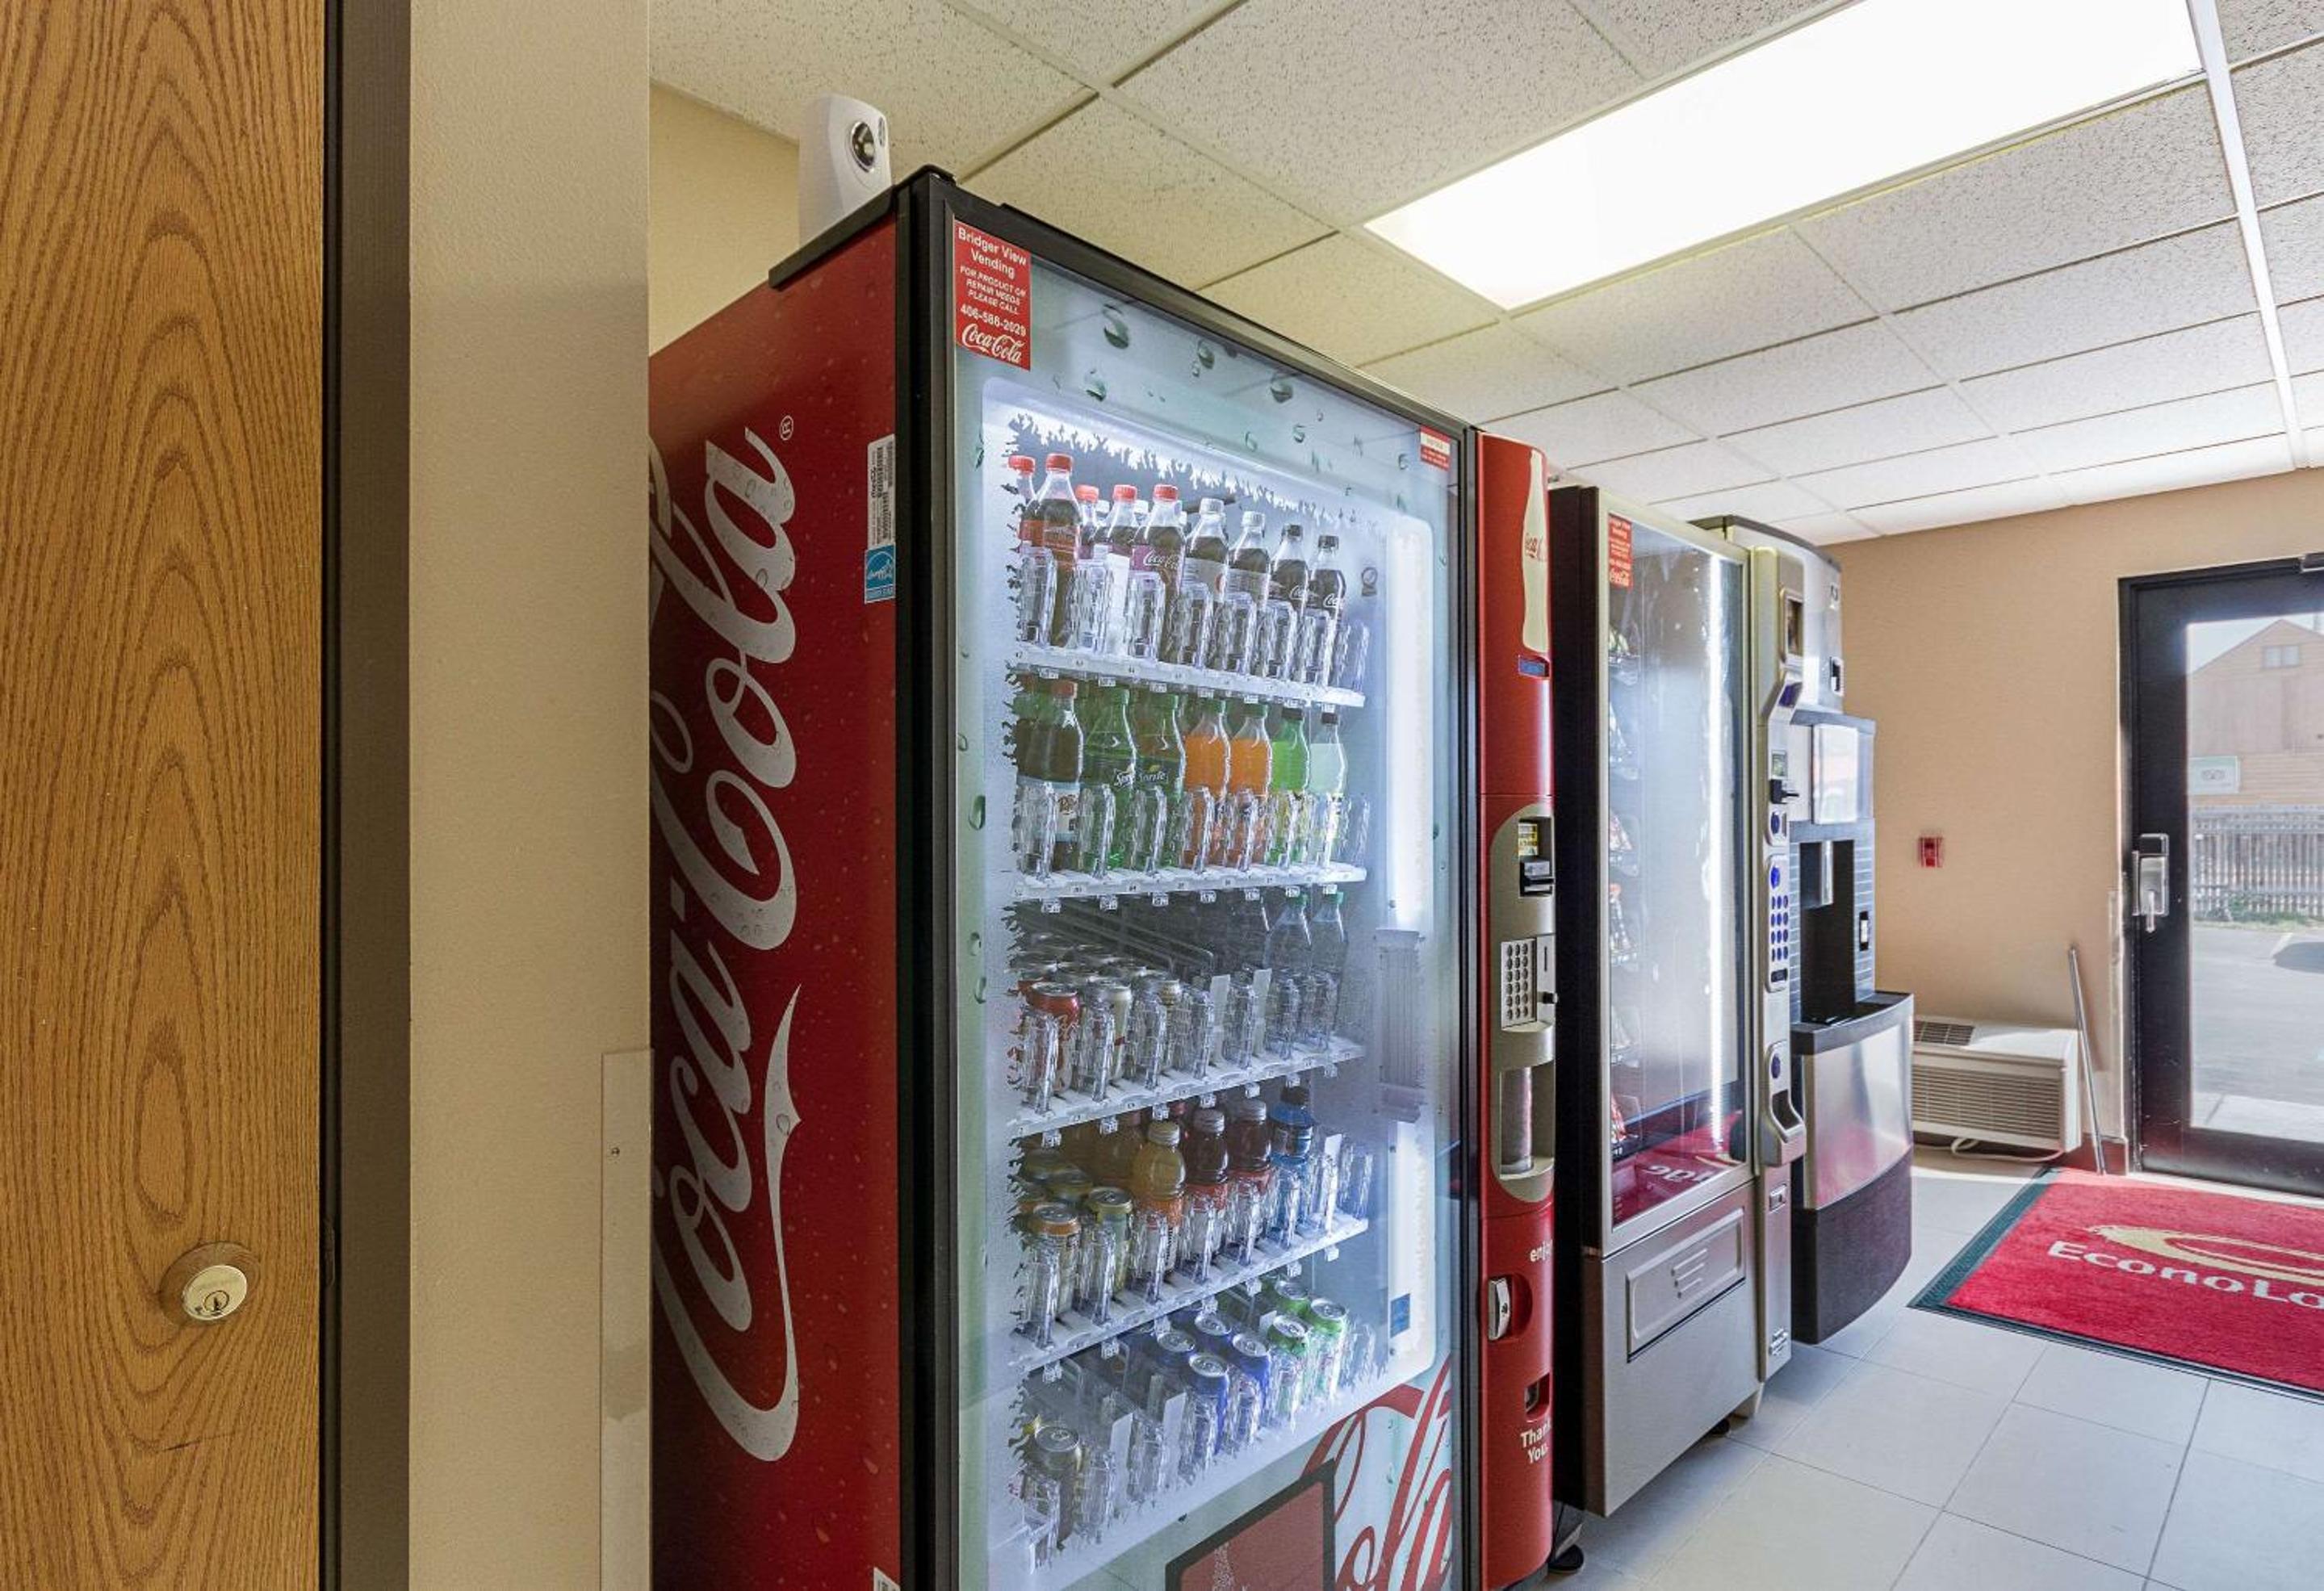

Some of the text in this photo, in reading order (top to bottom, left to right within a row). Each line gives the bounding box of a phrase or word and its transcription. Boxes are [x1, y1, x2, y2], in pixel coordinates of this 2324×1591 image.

[958, 227, 1027, 266] Bridger View
[970, 248, 1015, 280] Vending
[960, 265, 977, 278] FOR
[978, 272, 1013, 292] PRODUCT
[966, 278, 1020, 306] REPAIR NEEDS
[968, 289, 1019, 315] PLEASE CALL
